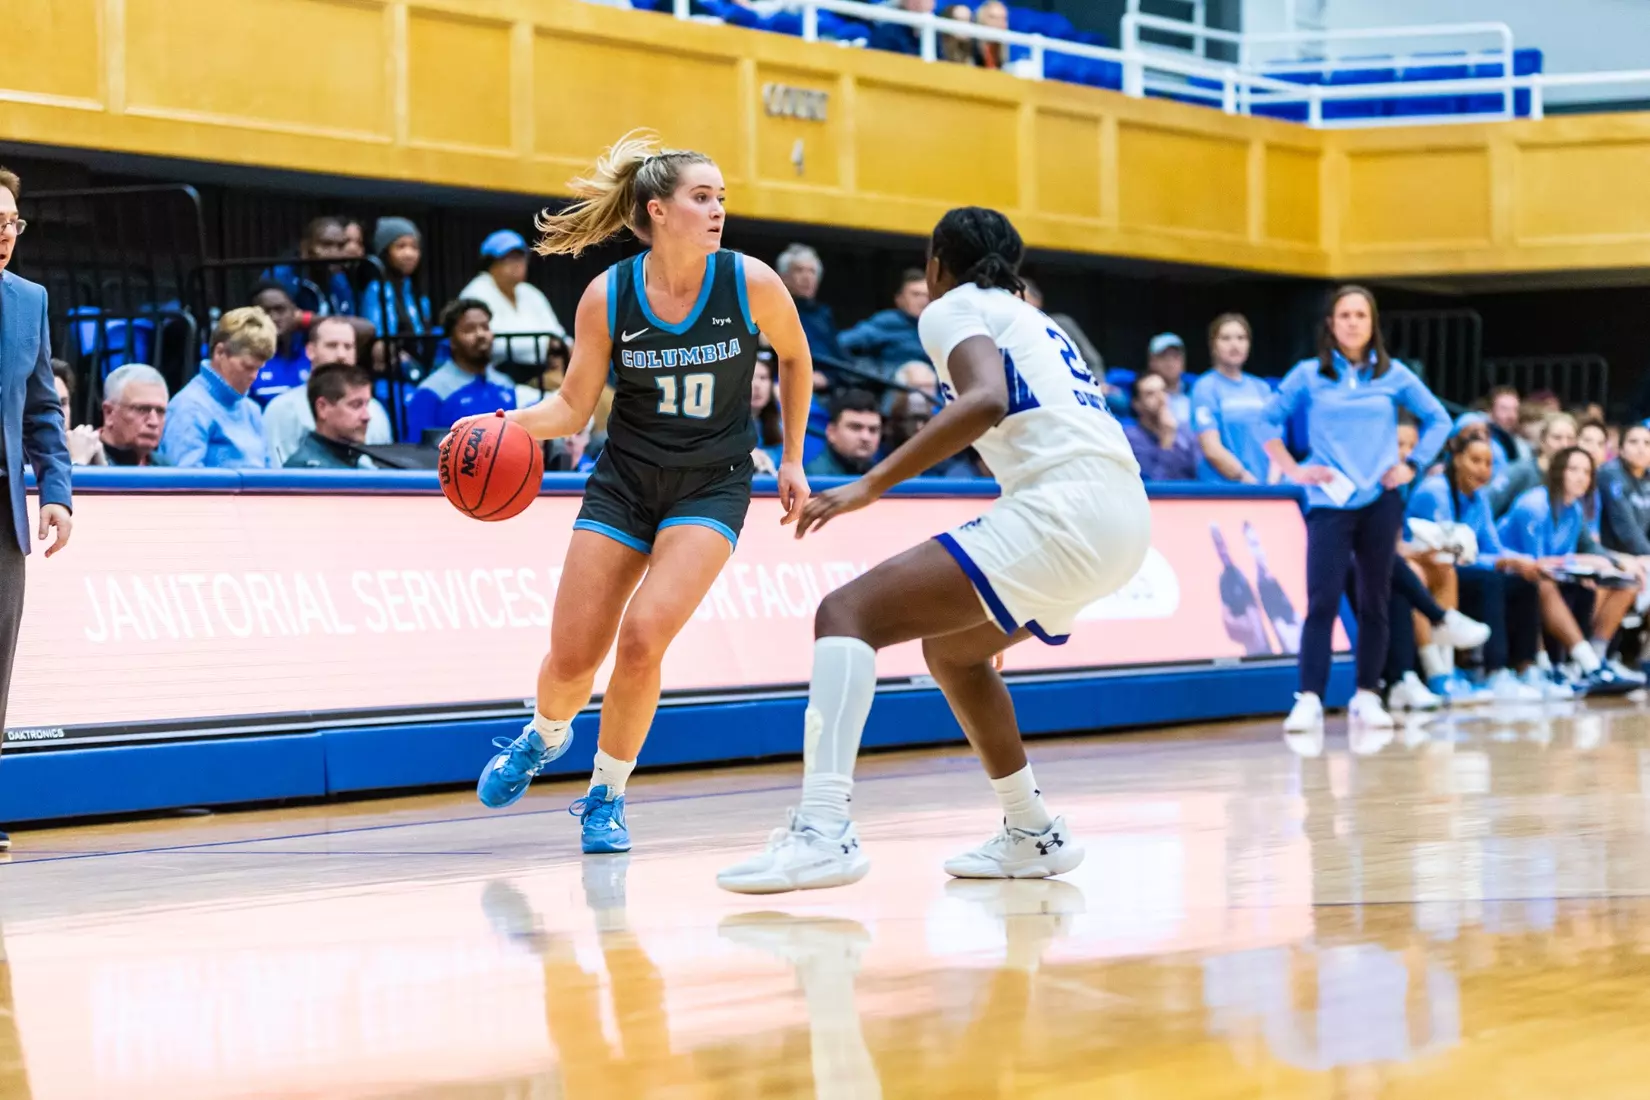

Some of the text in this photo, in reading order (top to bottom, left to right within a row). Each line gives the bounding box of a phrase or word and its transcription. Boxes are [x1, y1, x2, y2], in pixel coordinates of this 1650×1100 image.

[621, 338, 742, 369] COLUMBIA
[654, 372, 716, 419] 10
[460, 428, 486, 478] NCAA
[84, 571, 357, 643] JANITORIAL
[351, 567, 551, 634] SERVICES
[732, 561, 870, 620] FACILIT
[7, 728, 66, 741] DAKTRONICS
